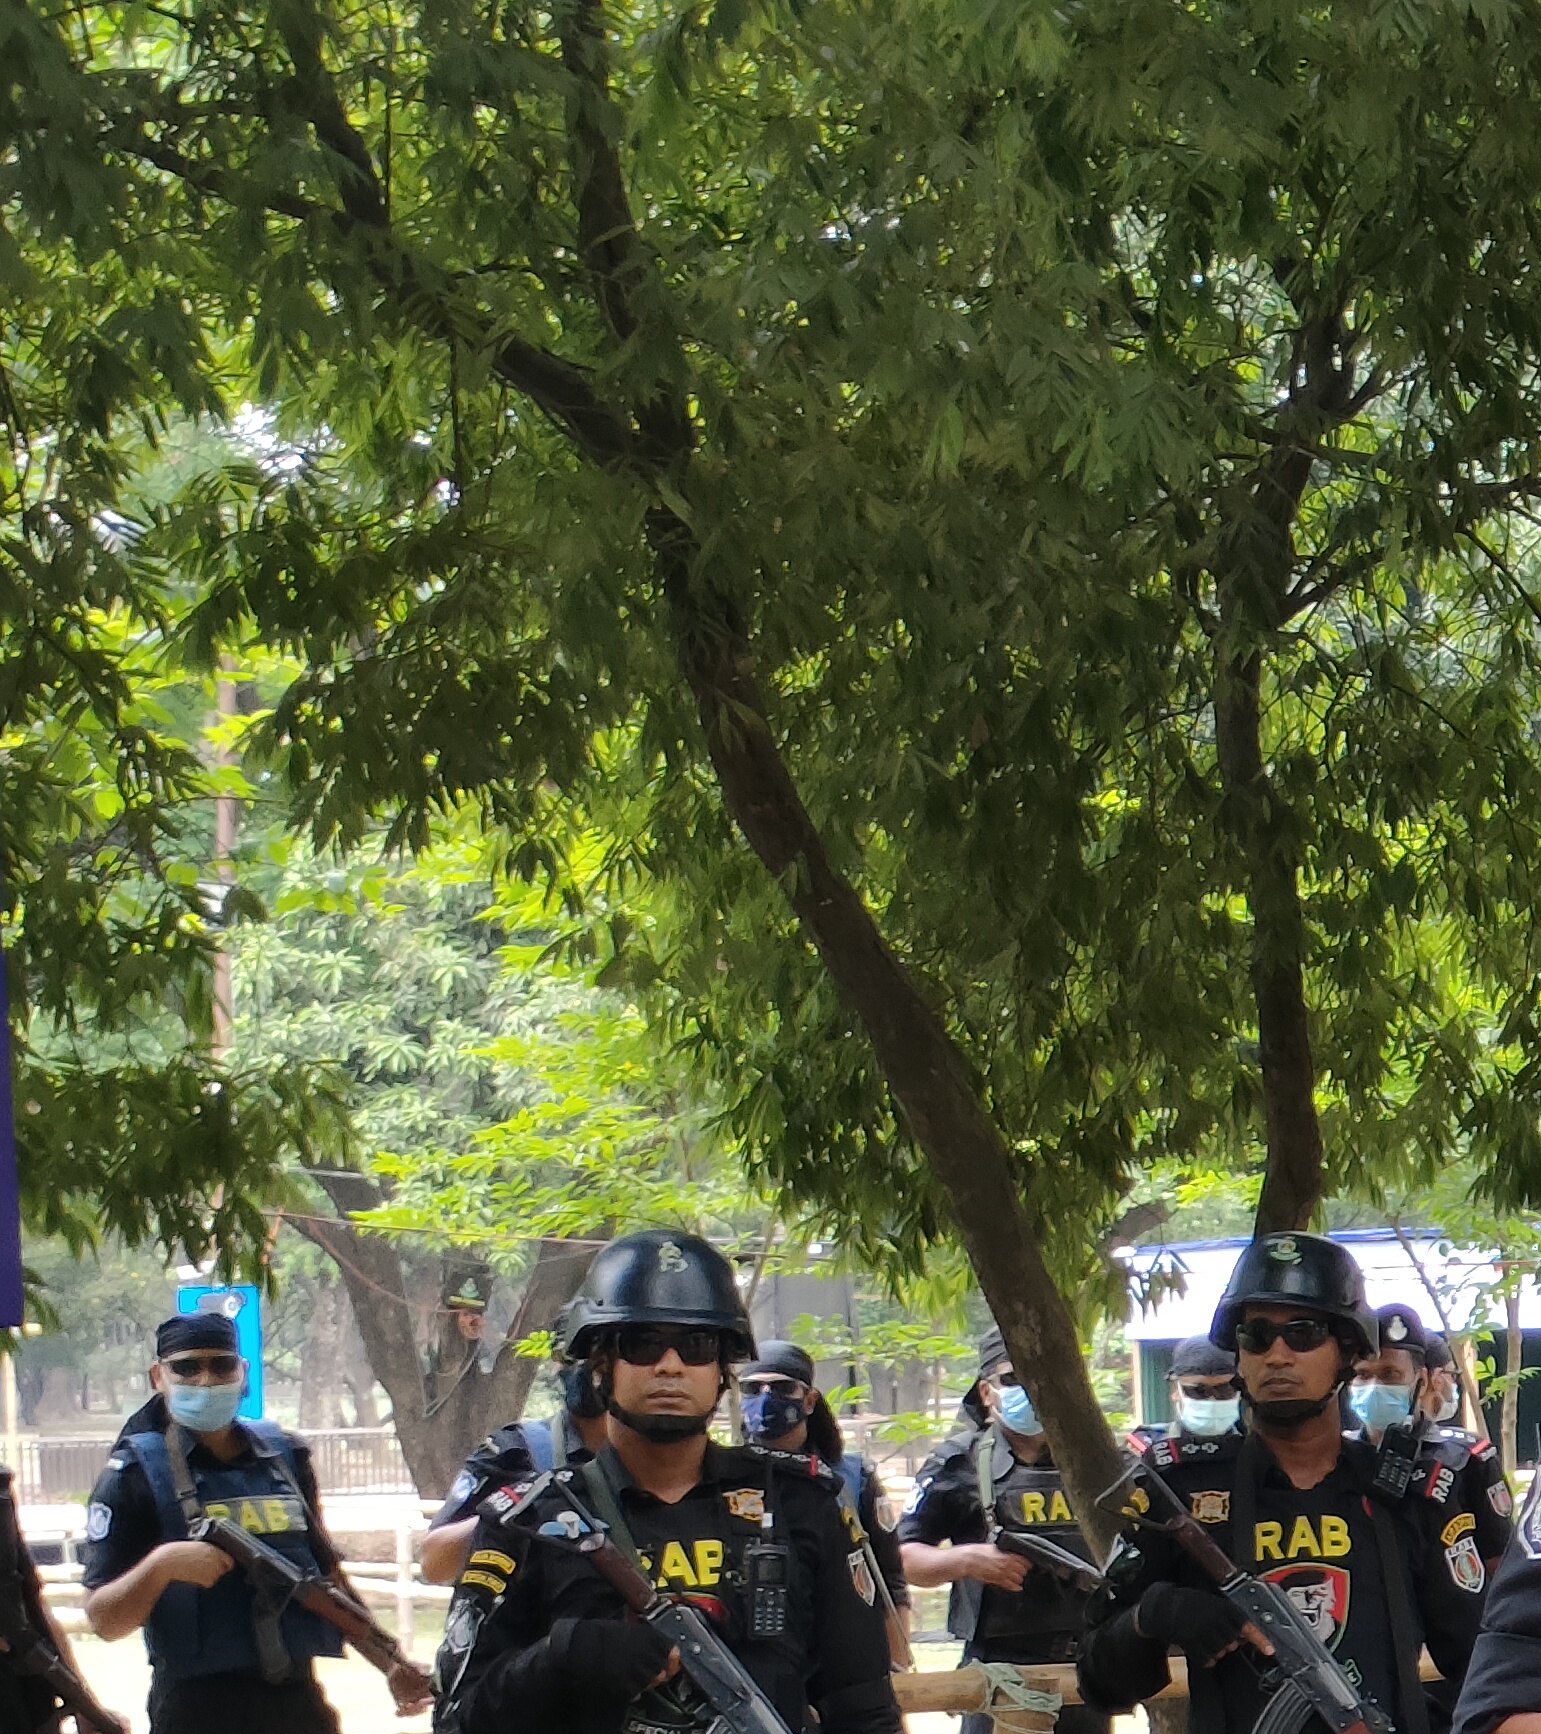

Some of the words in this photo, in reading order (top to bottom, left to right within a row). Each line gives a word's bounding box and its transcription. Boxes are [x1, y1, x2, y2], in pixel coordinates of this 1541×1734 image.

[1021, 1490, 1073, 1523] RA
[1431, 1467, 1455, 1504] RAB
[1254, 1515, 1352, 1562] RAB
[636, 1539, 724, 1588] AB
